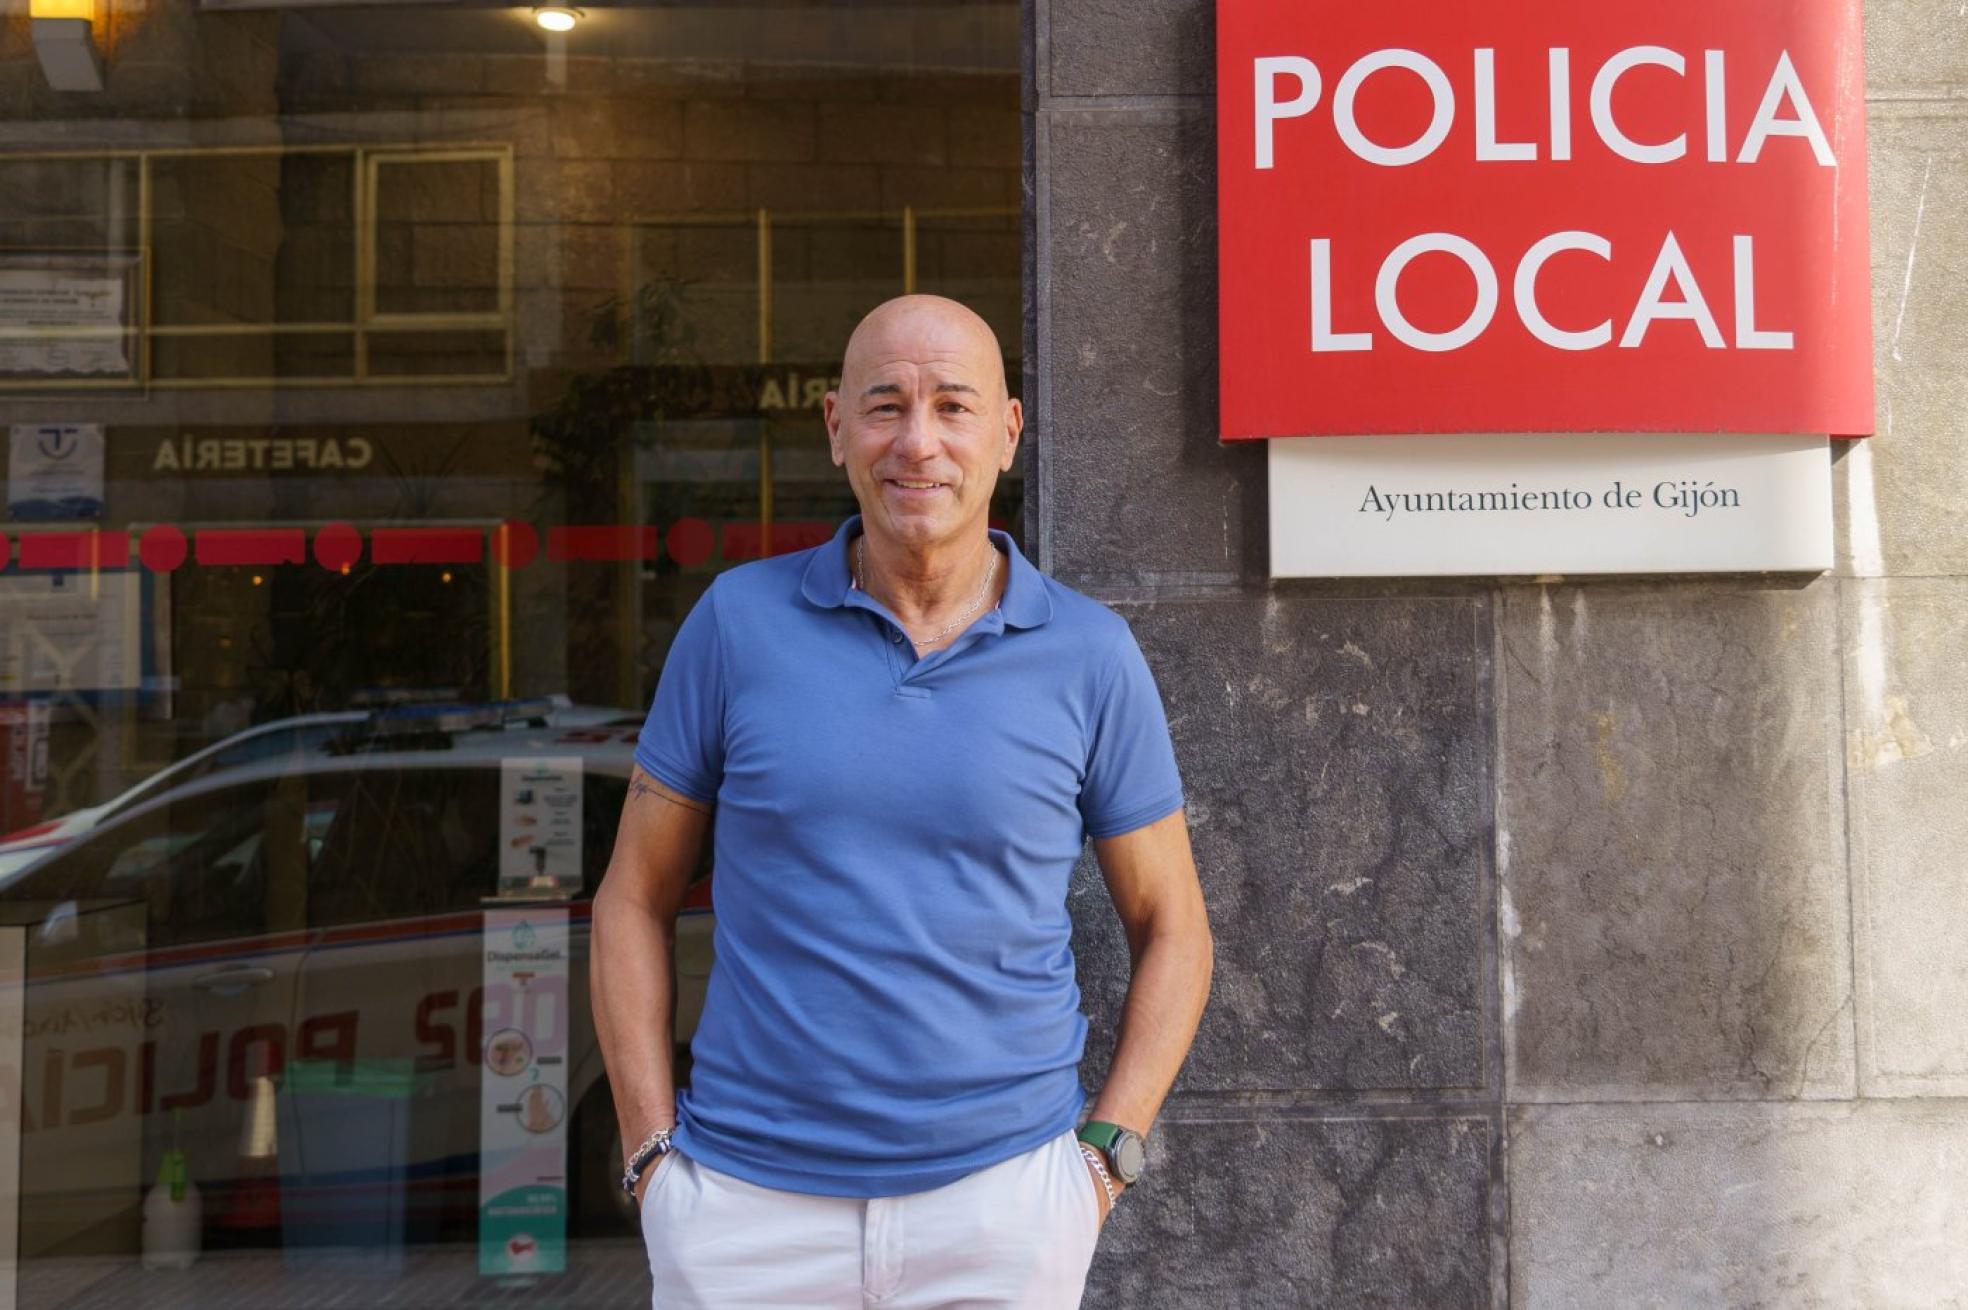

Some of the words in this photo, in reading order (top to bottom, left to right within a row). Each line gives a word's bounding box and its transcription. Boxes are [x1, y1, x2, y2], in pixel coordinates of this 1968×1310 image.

[1254, 46, 1838, 170] POLICIA
[1310, 229, 1795, 353] LOCAL
[1358, 484, 1592, 520] Ayuntamiento
[1603, 481, 1642, 509] de
[1653, 481, 1740, 519] Gijón
